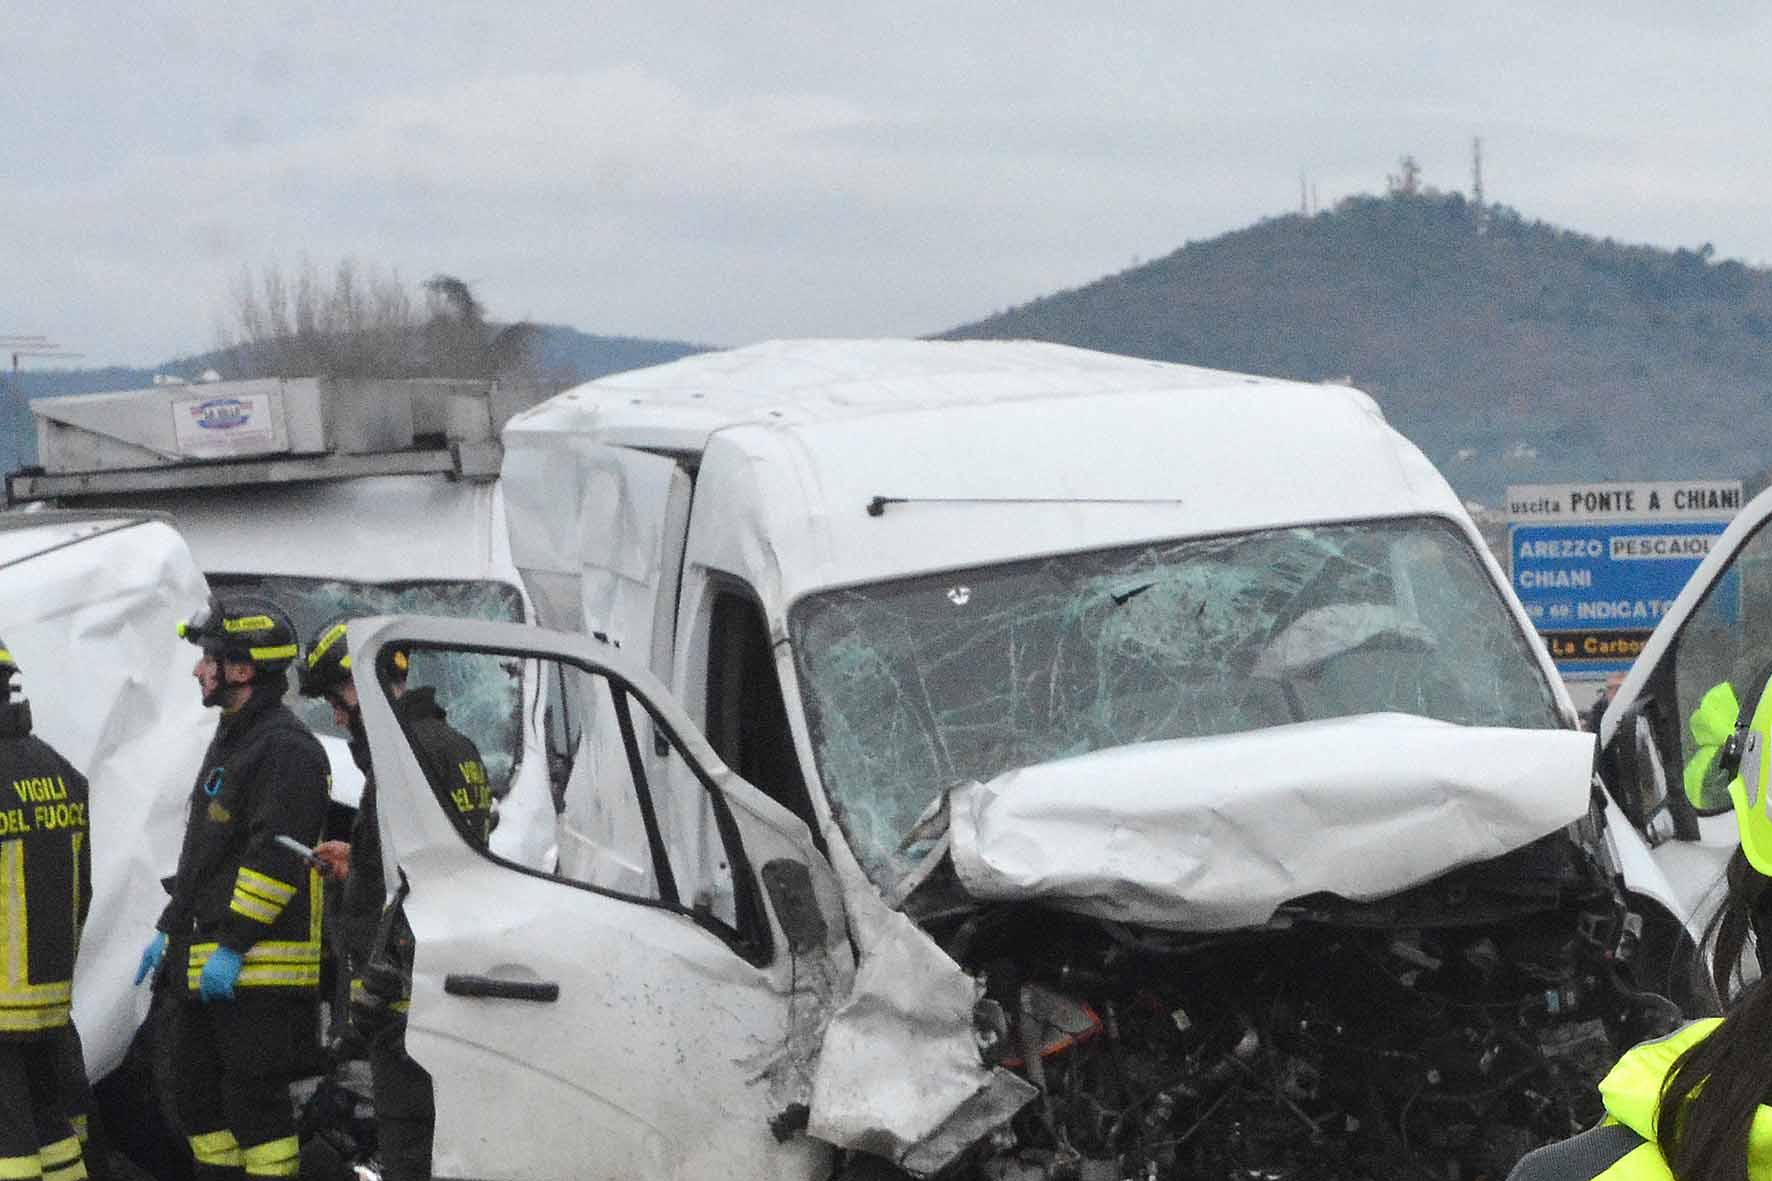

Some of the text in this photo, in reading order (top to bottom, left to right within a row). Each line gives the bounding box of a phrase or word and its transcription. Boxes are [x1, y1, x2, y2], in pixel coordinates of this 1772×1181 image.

[1511, 488, 1740, 514] uscita PONTE A CHIANI
[1519, 537, 1712, 559] AREZZO PESCAIOL
[1518, 569, 1592, 590] CHIANI
[1552, 635, 1647, 657] La Carbo
[12, 776, 68, 802] VIGILI
